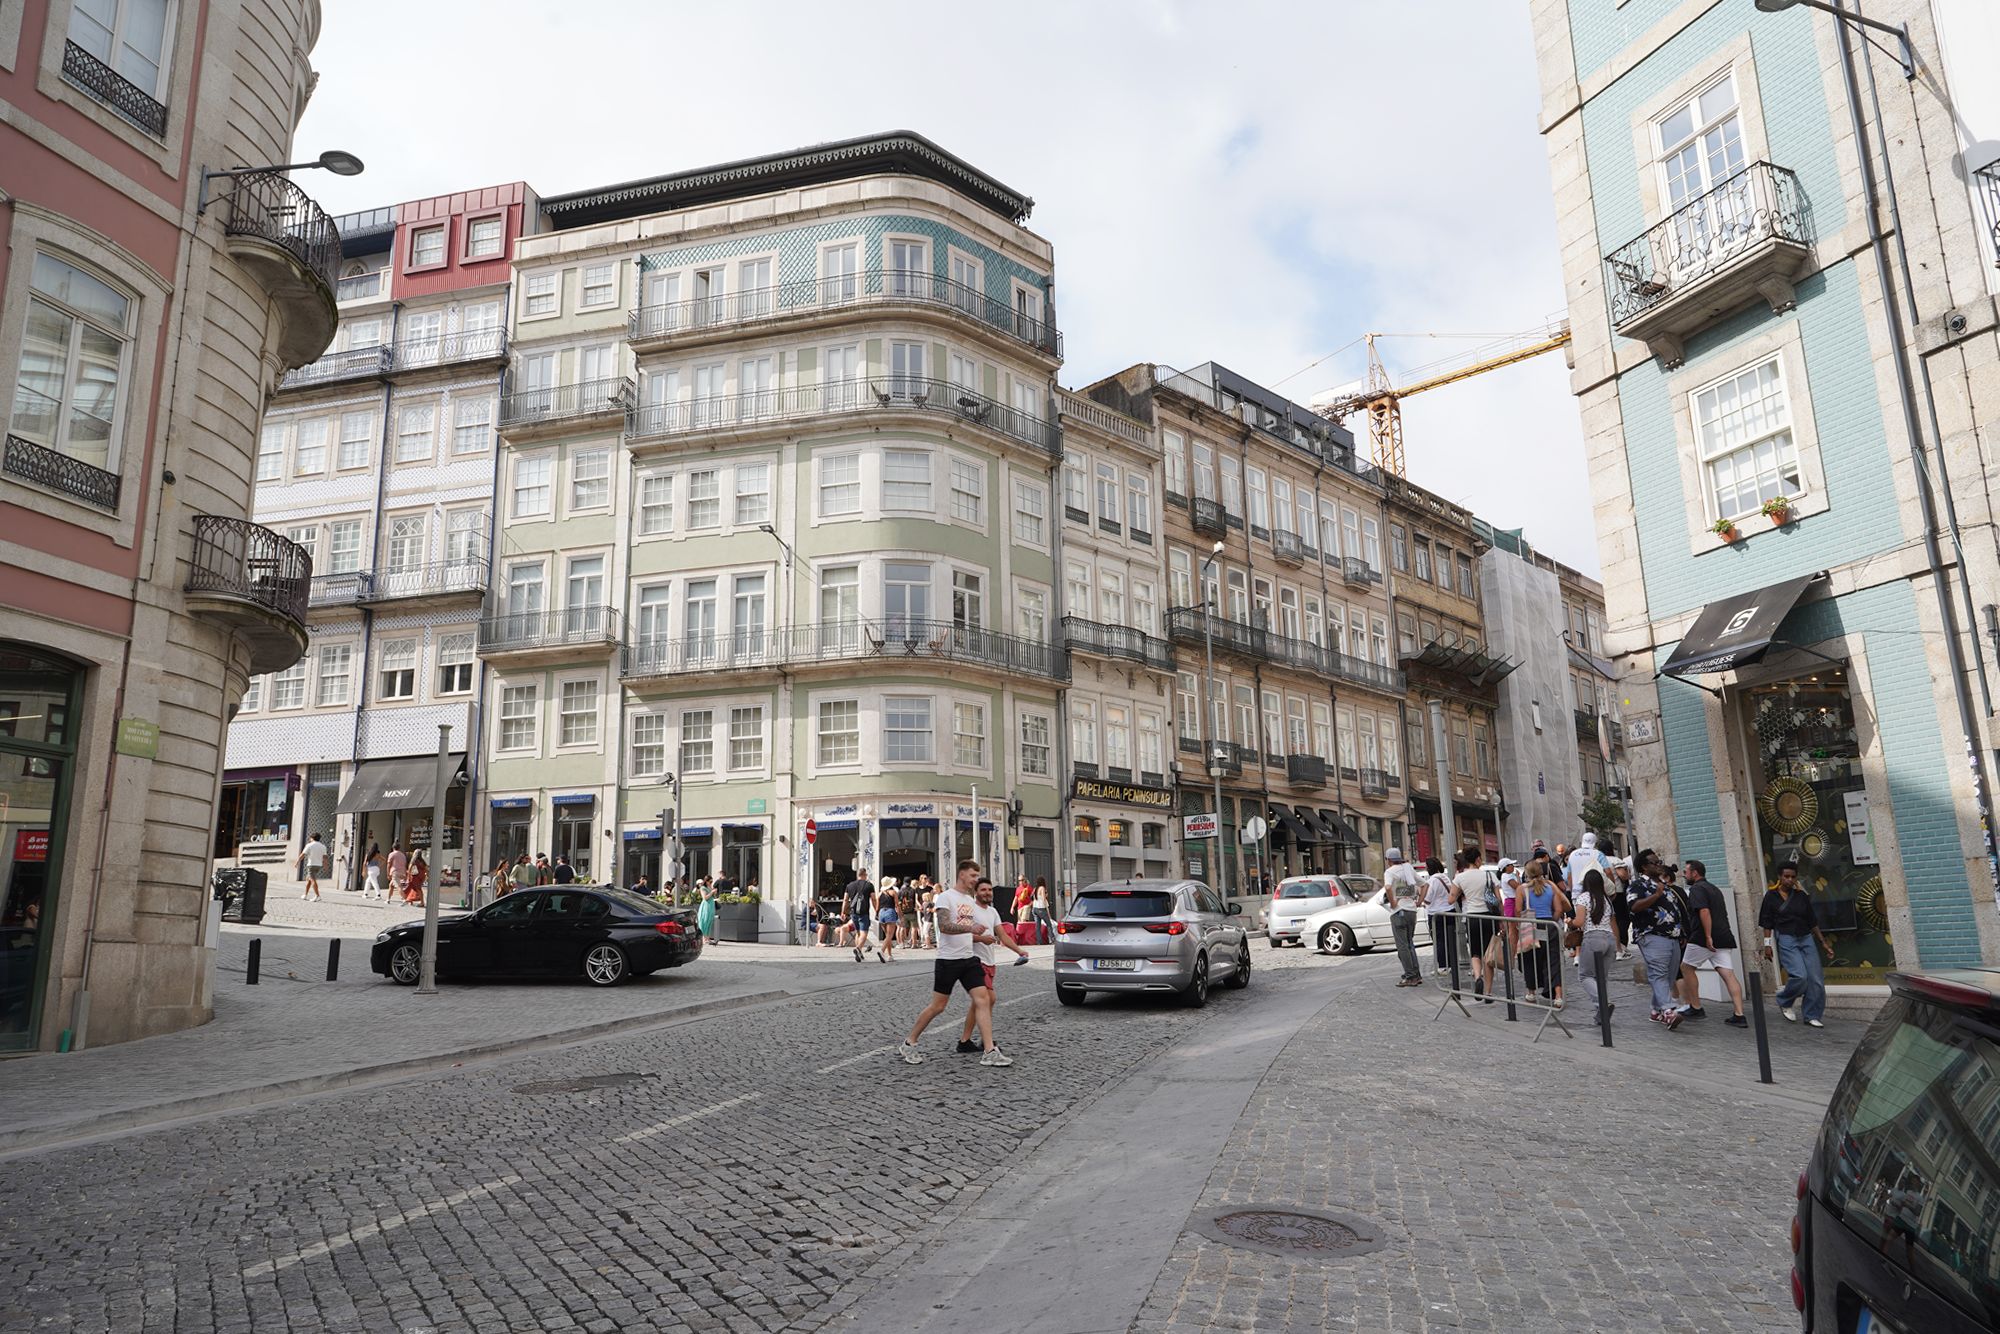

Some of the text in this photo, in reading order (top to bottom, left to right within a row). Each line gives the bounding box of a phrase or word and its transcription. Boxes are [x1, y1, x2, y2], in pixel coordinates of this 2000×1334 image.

[382, 789, 411, 799] MESH
[1076, 781, 1172, 806] PAPELARIA PENINSULAR
